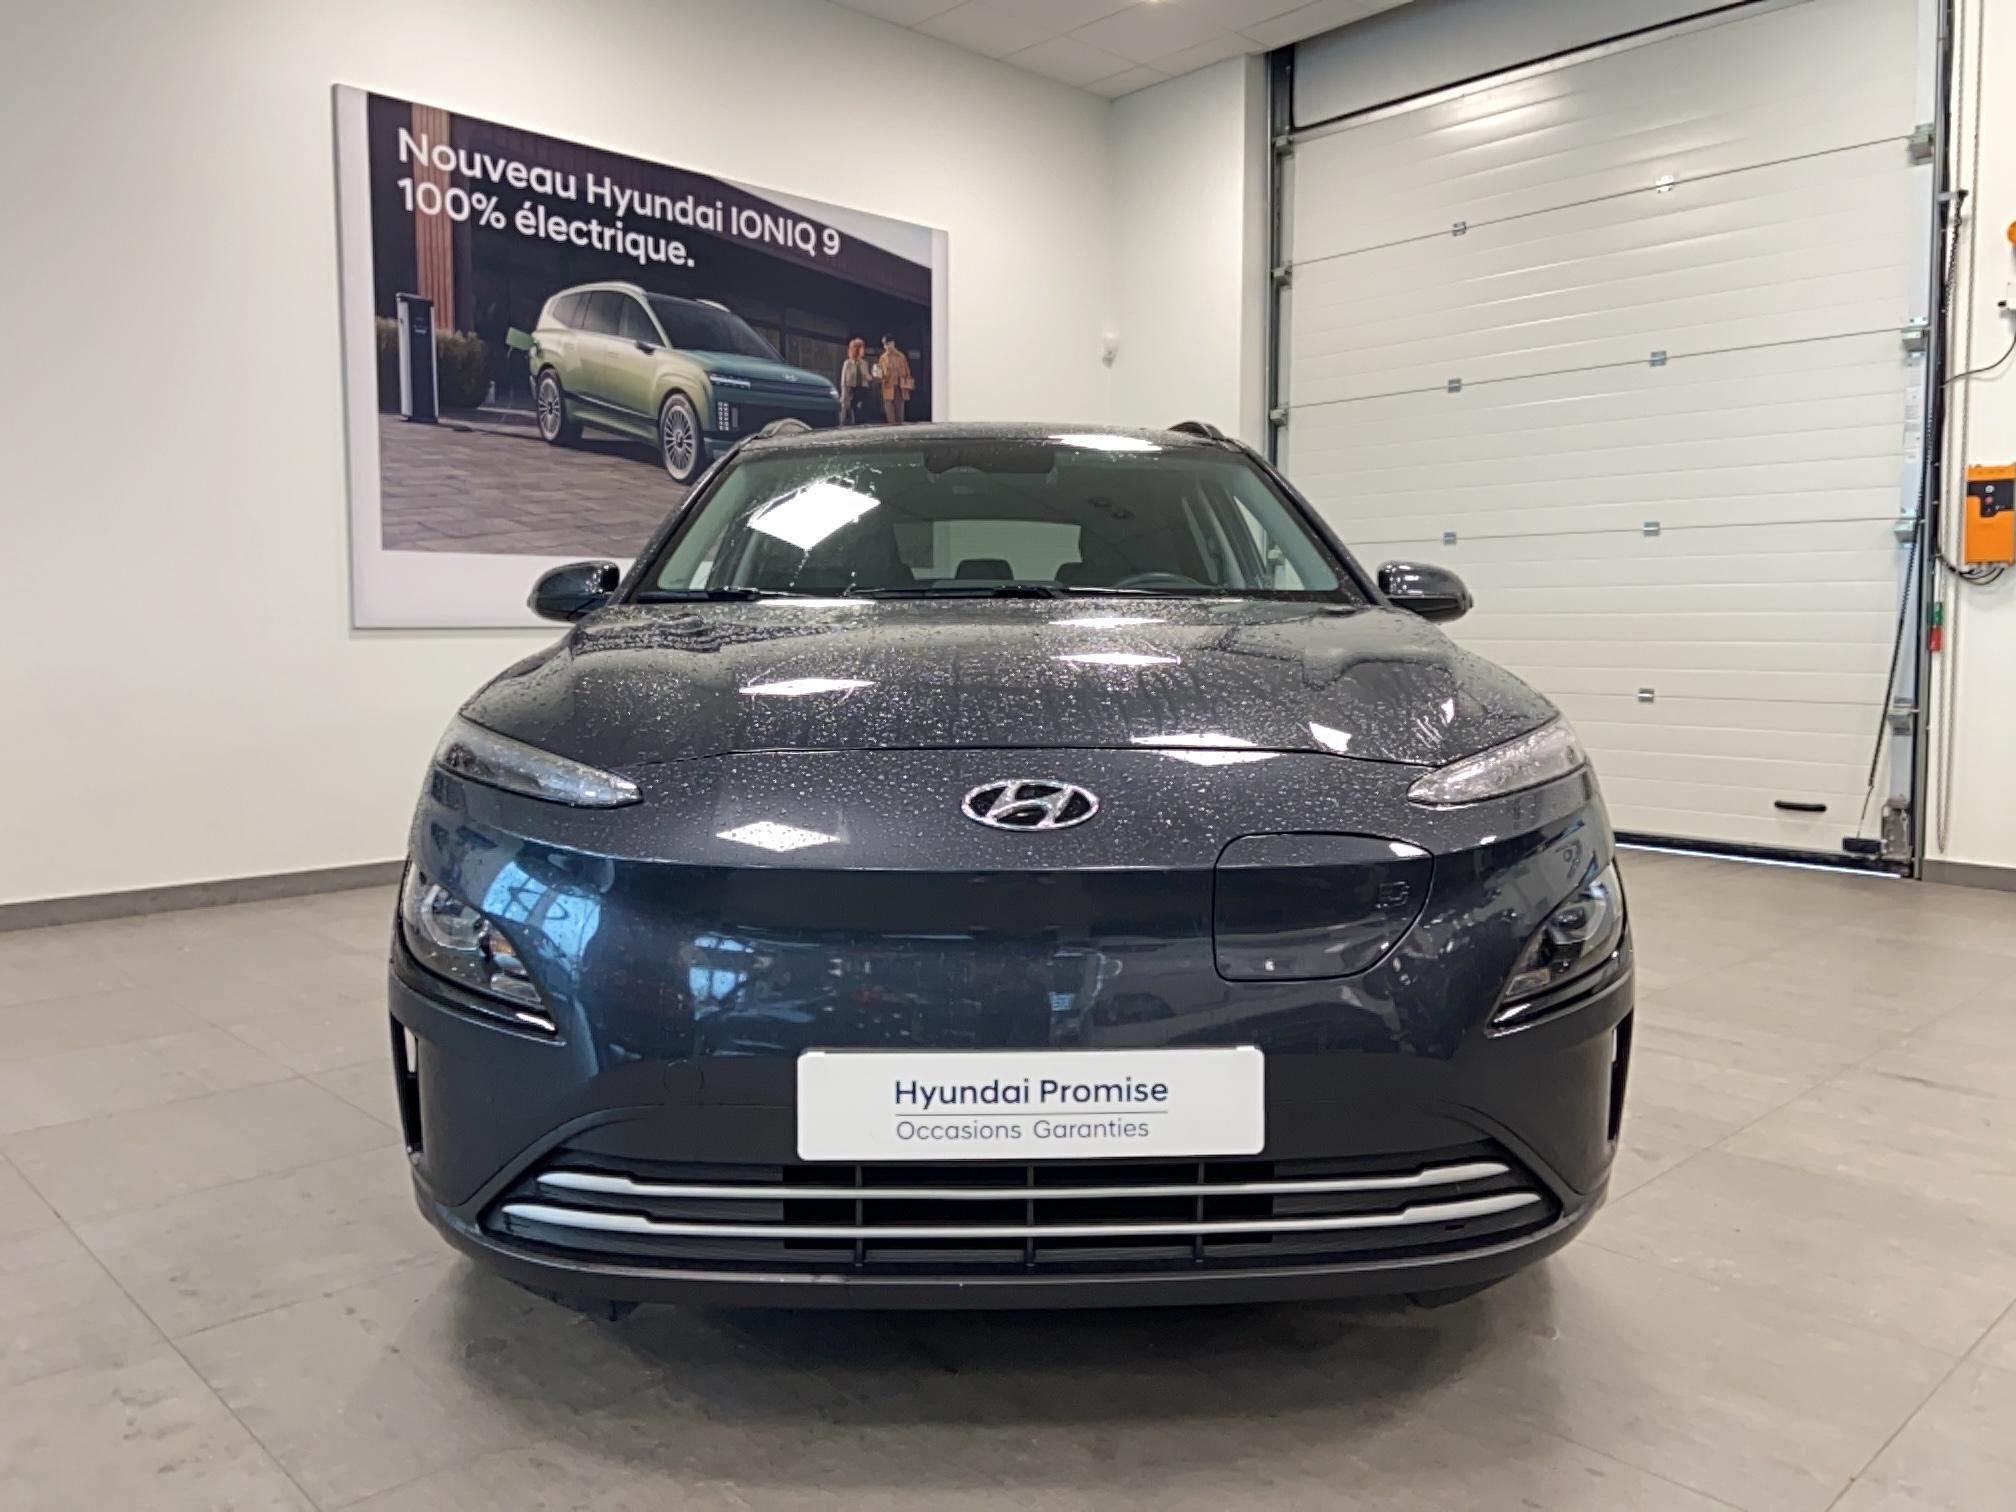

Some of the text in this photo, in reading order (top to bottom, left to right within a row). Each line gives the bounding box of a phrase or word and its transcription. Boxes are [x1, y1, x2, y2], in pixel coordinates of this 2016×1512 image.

[397, 177, 695, 268] 100% électrique.
[398, 126, 841, 257] Nouveau Hyundai IONIQ 9
[894, 1076, 1169, 1110] Hyundai Promise
[896, 1117, 1150, 1140] Occasions Garanties
